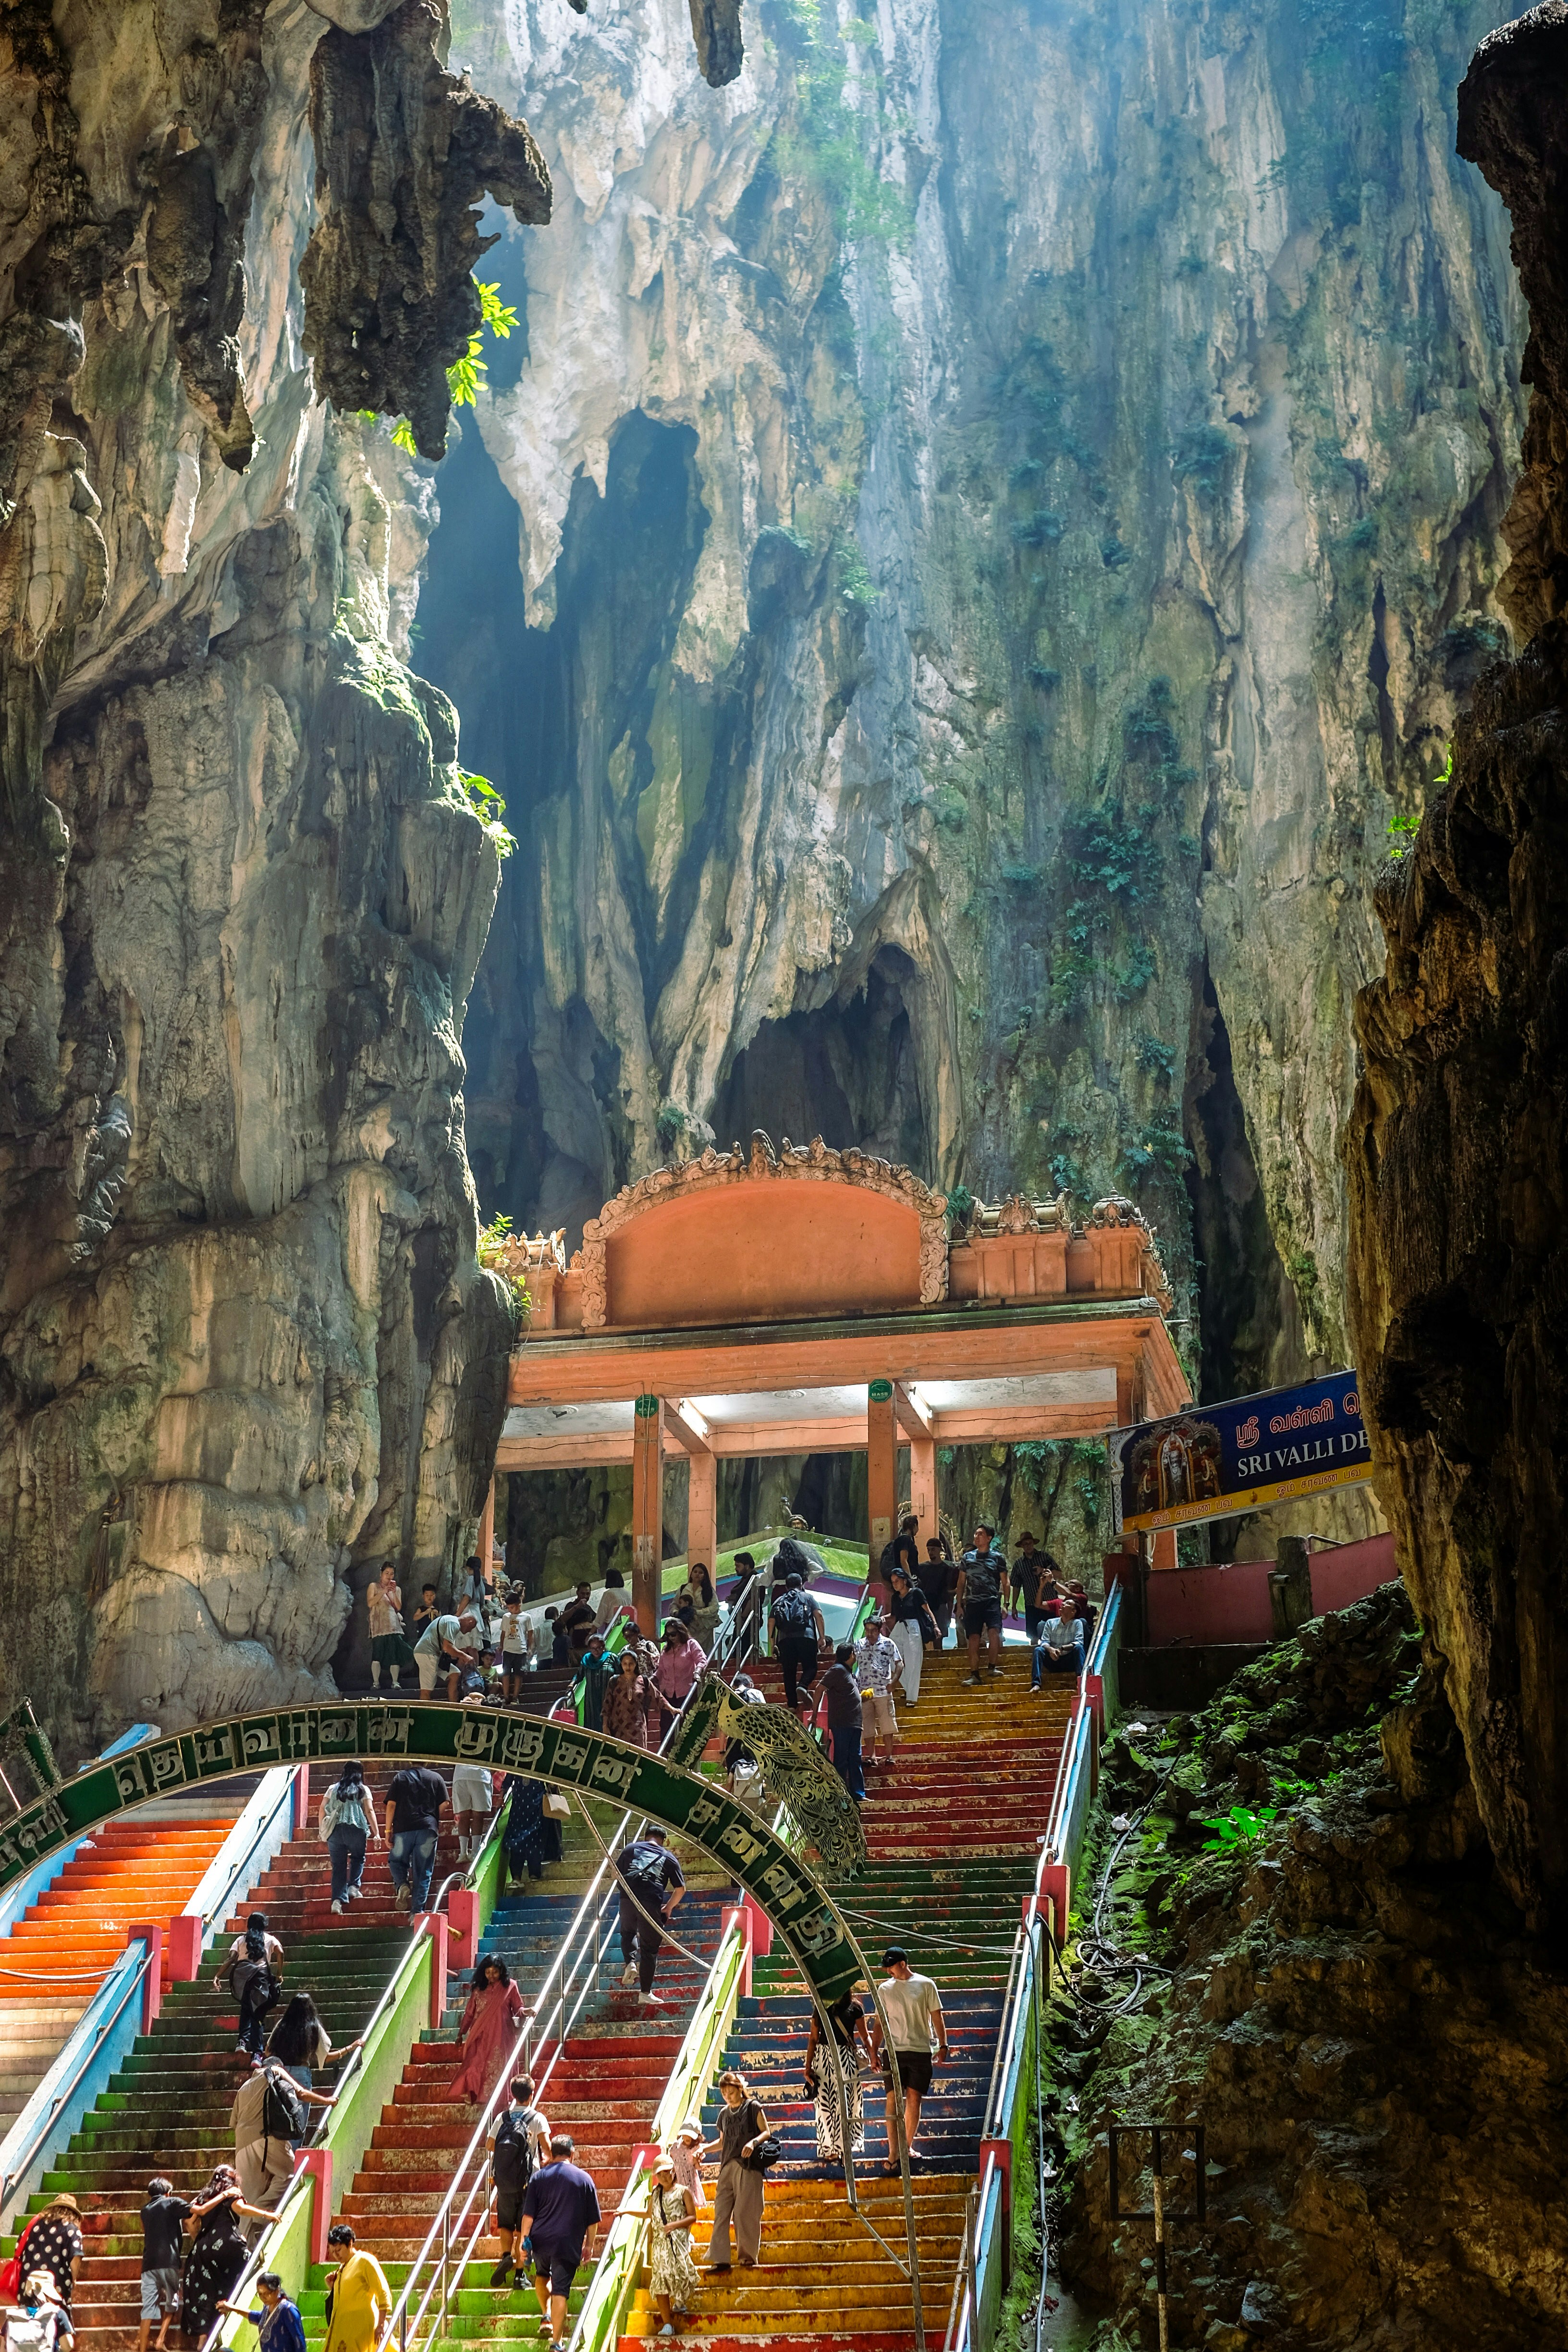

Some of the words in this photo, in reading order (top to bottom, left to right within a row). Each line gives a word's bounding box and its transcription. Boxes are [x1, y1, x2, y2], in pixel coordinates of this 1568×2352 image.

[1237, 1416, 1259, 1448] ஸ்ரீ
[1270, 1398, 1334, 1433] வள்ளி
[1238, 1452, 1272, 1477] SRI
[1274, 1437, 1335, 1467] VALLI
[1276, 1481, 1295, 1498] ஓம்
[1300, 1472, 1338, 1490] சரவண
[1343, 1467, 1361, 1479] பவ
[1152, 1510, 1170, 1526] ஓம்
[1176, 1503, 1211, 1519] சரவண
[1216, 1498, 1233, 1509] பவ
[454, 1722, 642, 1788] முருகன்
[689, 1799, 844, 1960] சன்னதி
